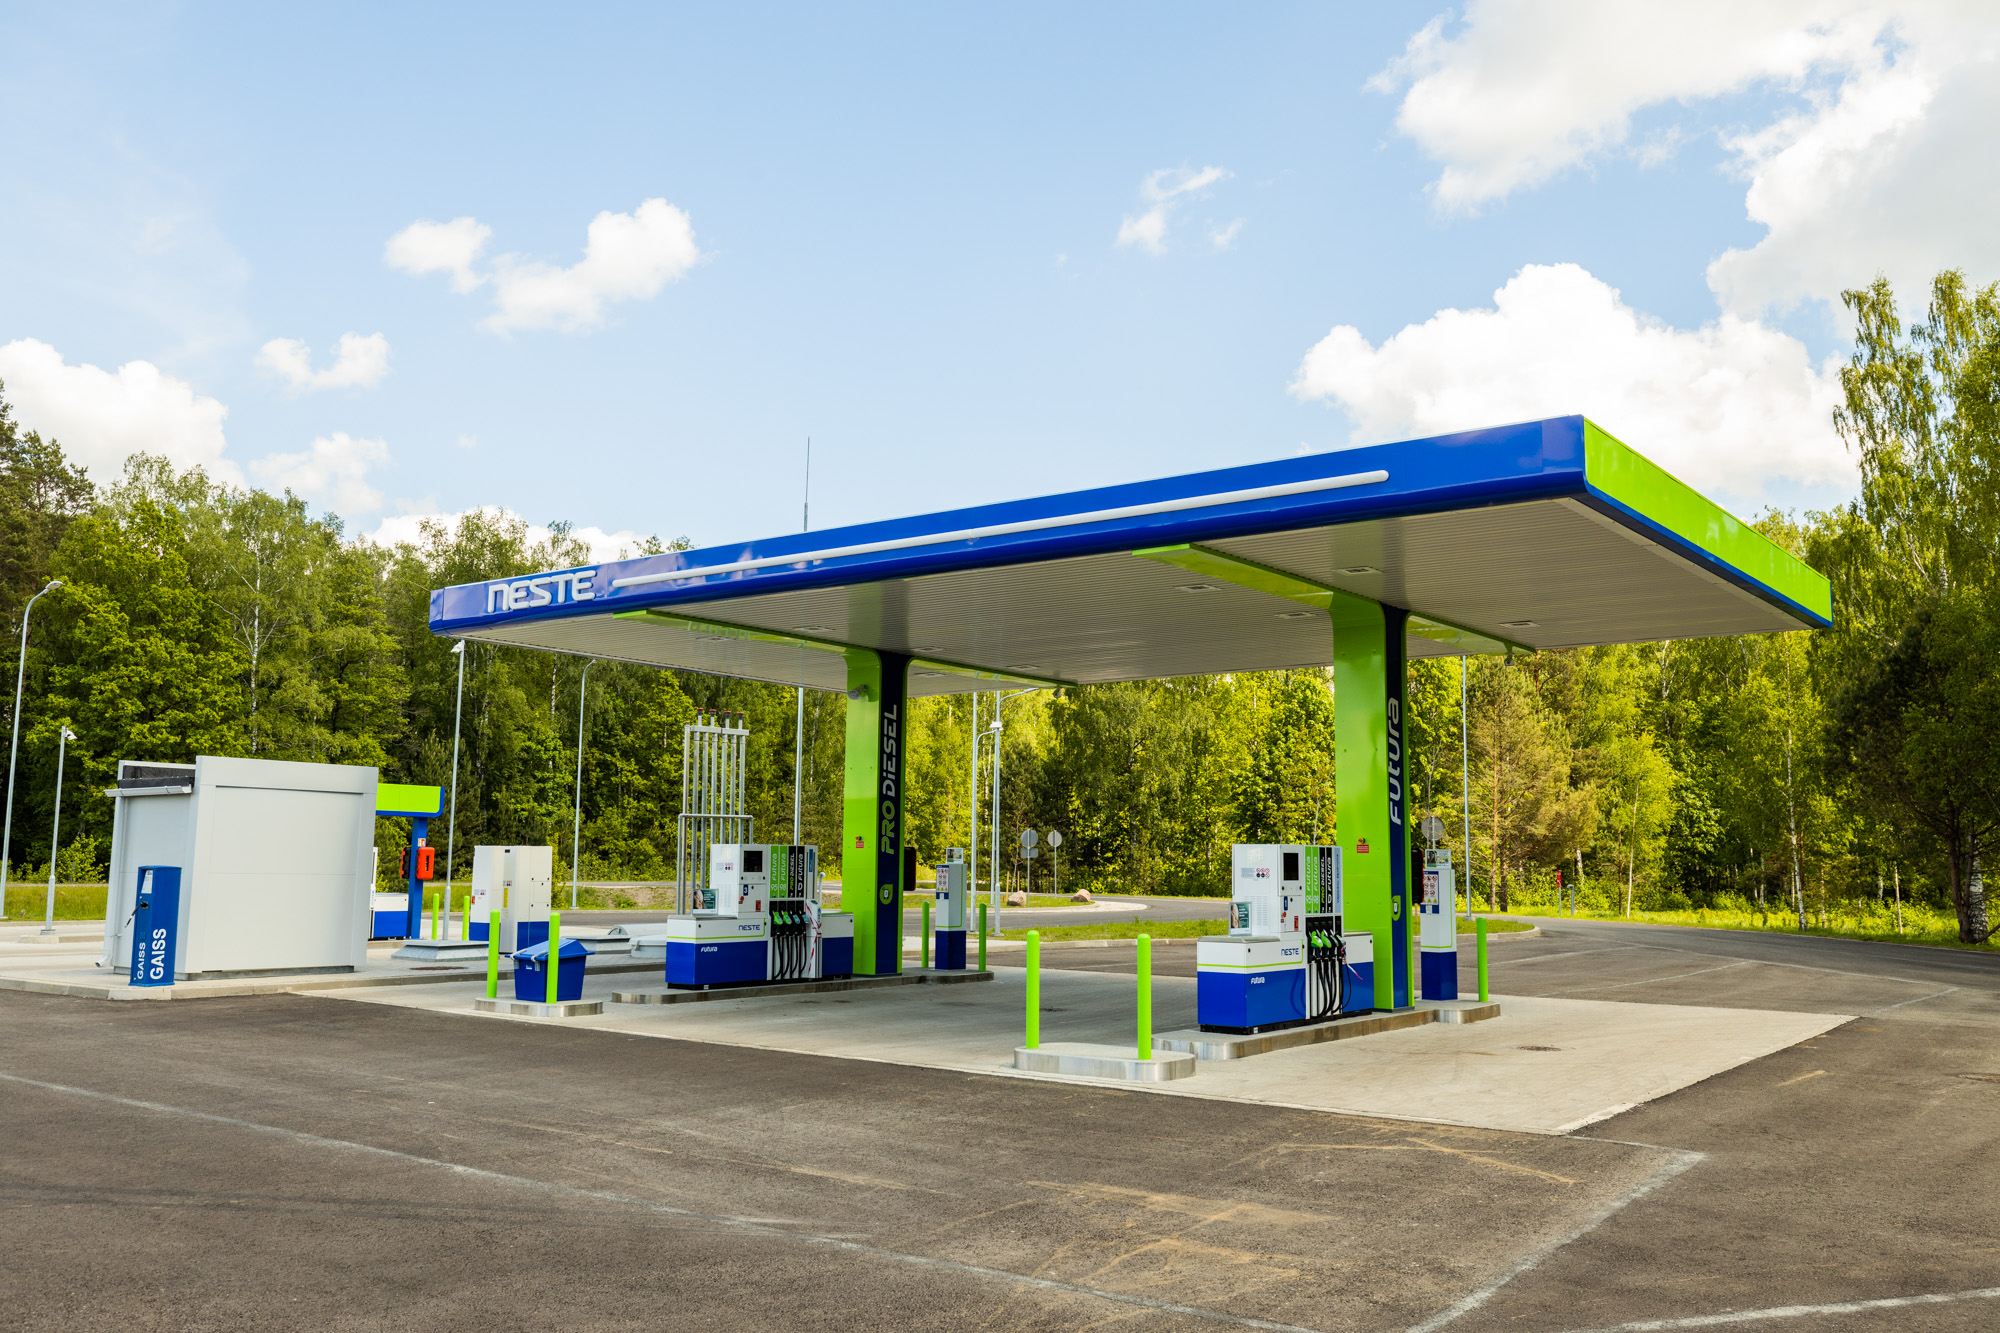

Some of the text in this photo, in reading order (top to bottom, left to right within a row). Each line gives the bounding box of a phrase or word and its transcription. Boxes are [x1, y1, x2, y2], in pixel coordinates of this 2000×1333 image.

[487, 570, 597, 613] NESTE
[1388, 697, 1401, 826] Futura
[881, 800, 895, 855] PRO
[743, 886, 748, 894] 3
[137, 942, 146, 980] GAISS
[150, 928, 167, 980] GAISS
[1280, 947, 1300, 956] NESTE
